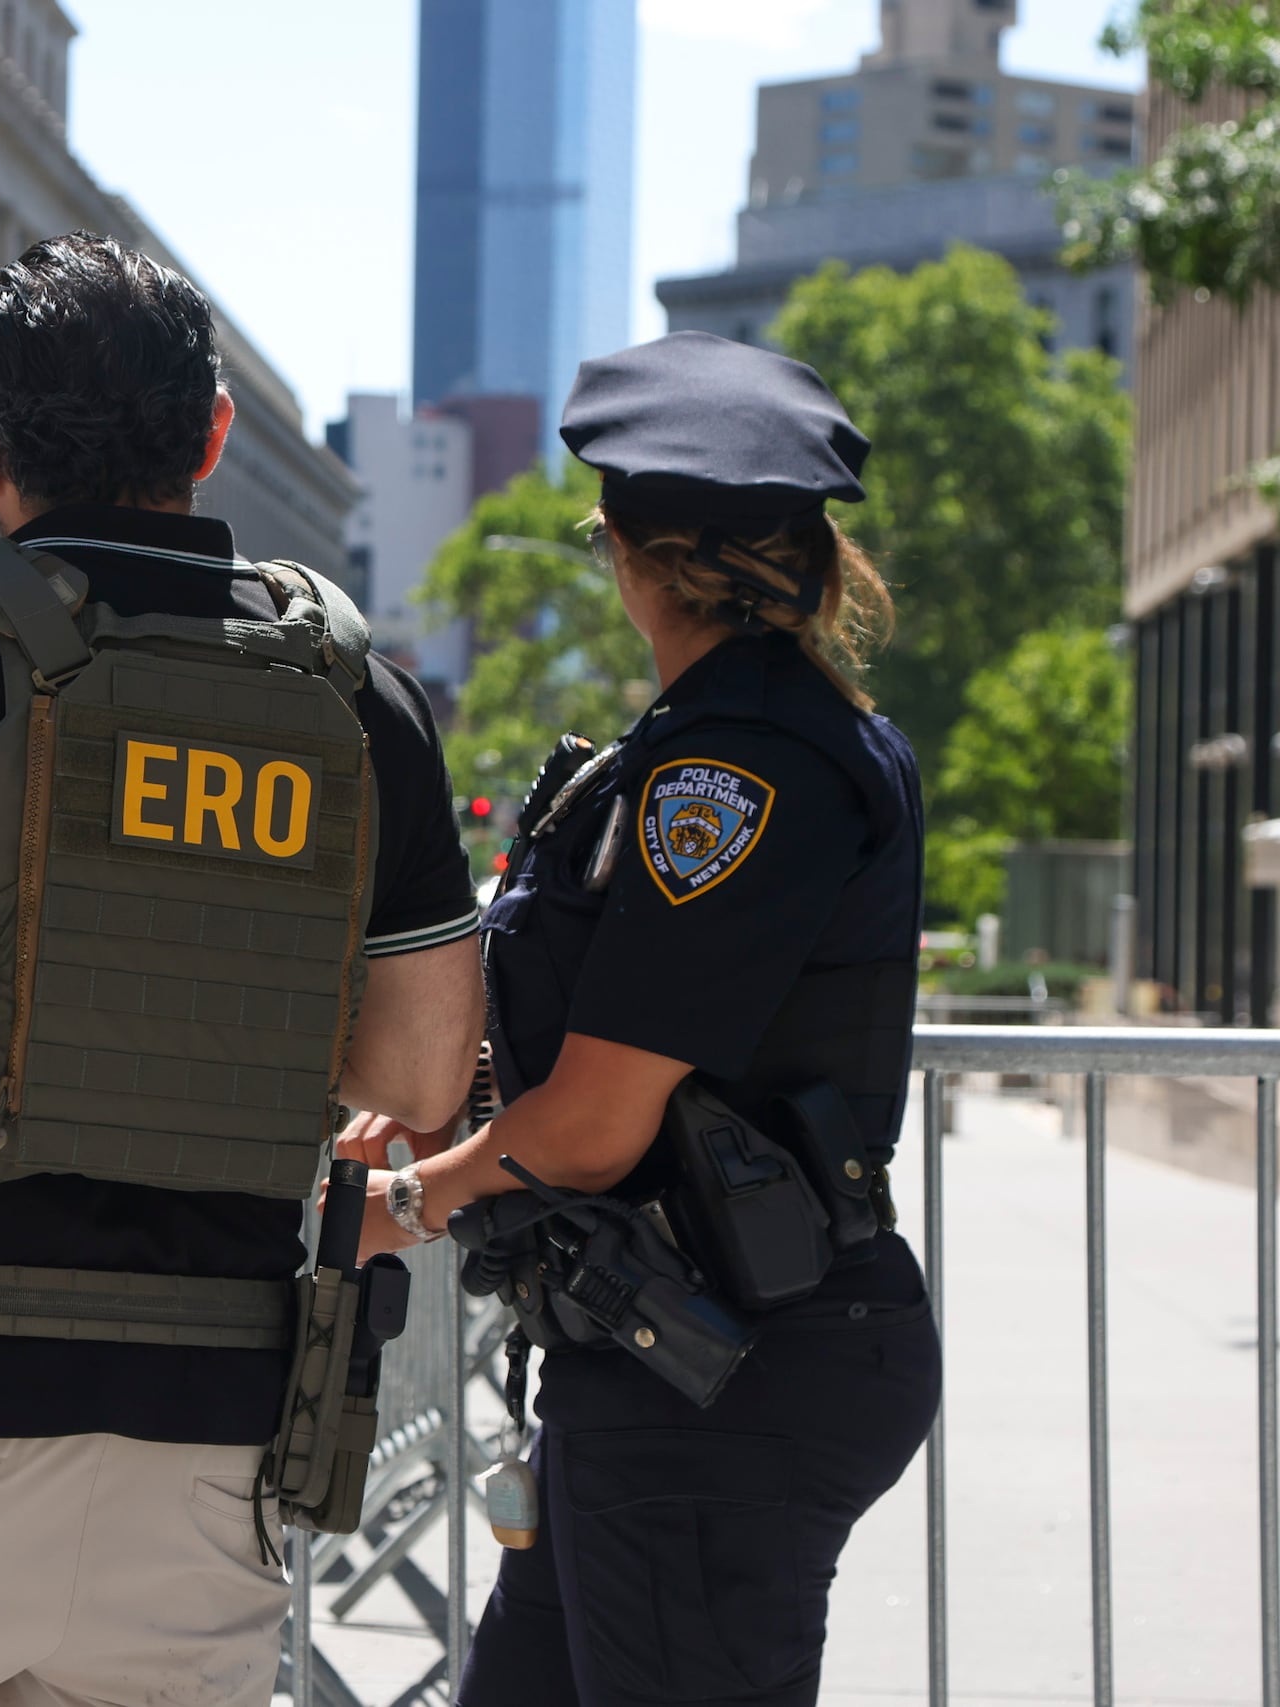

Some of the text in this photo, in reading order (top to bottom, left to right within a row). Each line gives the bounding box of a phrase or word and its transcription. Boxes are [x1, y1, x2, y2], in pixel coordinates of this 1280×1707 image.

[123, 740, 312, 857] ERO
[654, 781, 758, 817] DEPARTMENT
[680, 768, 741, 792] POLICE
[646, 816, 670, 874] CITY OF
[689, 826, 755, 888] NEW YORK
